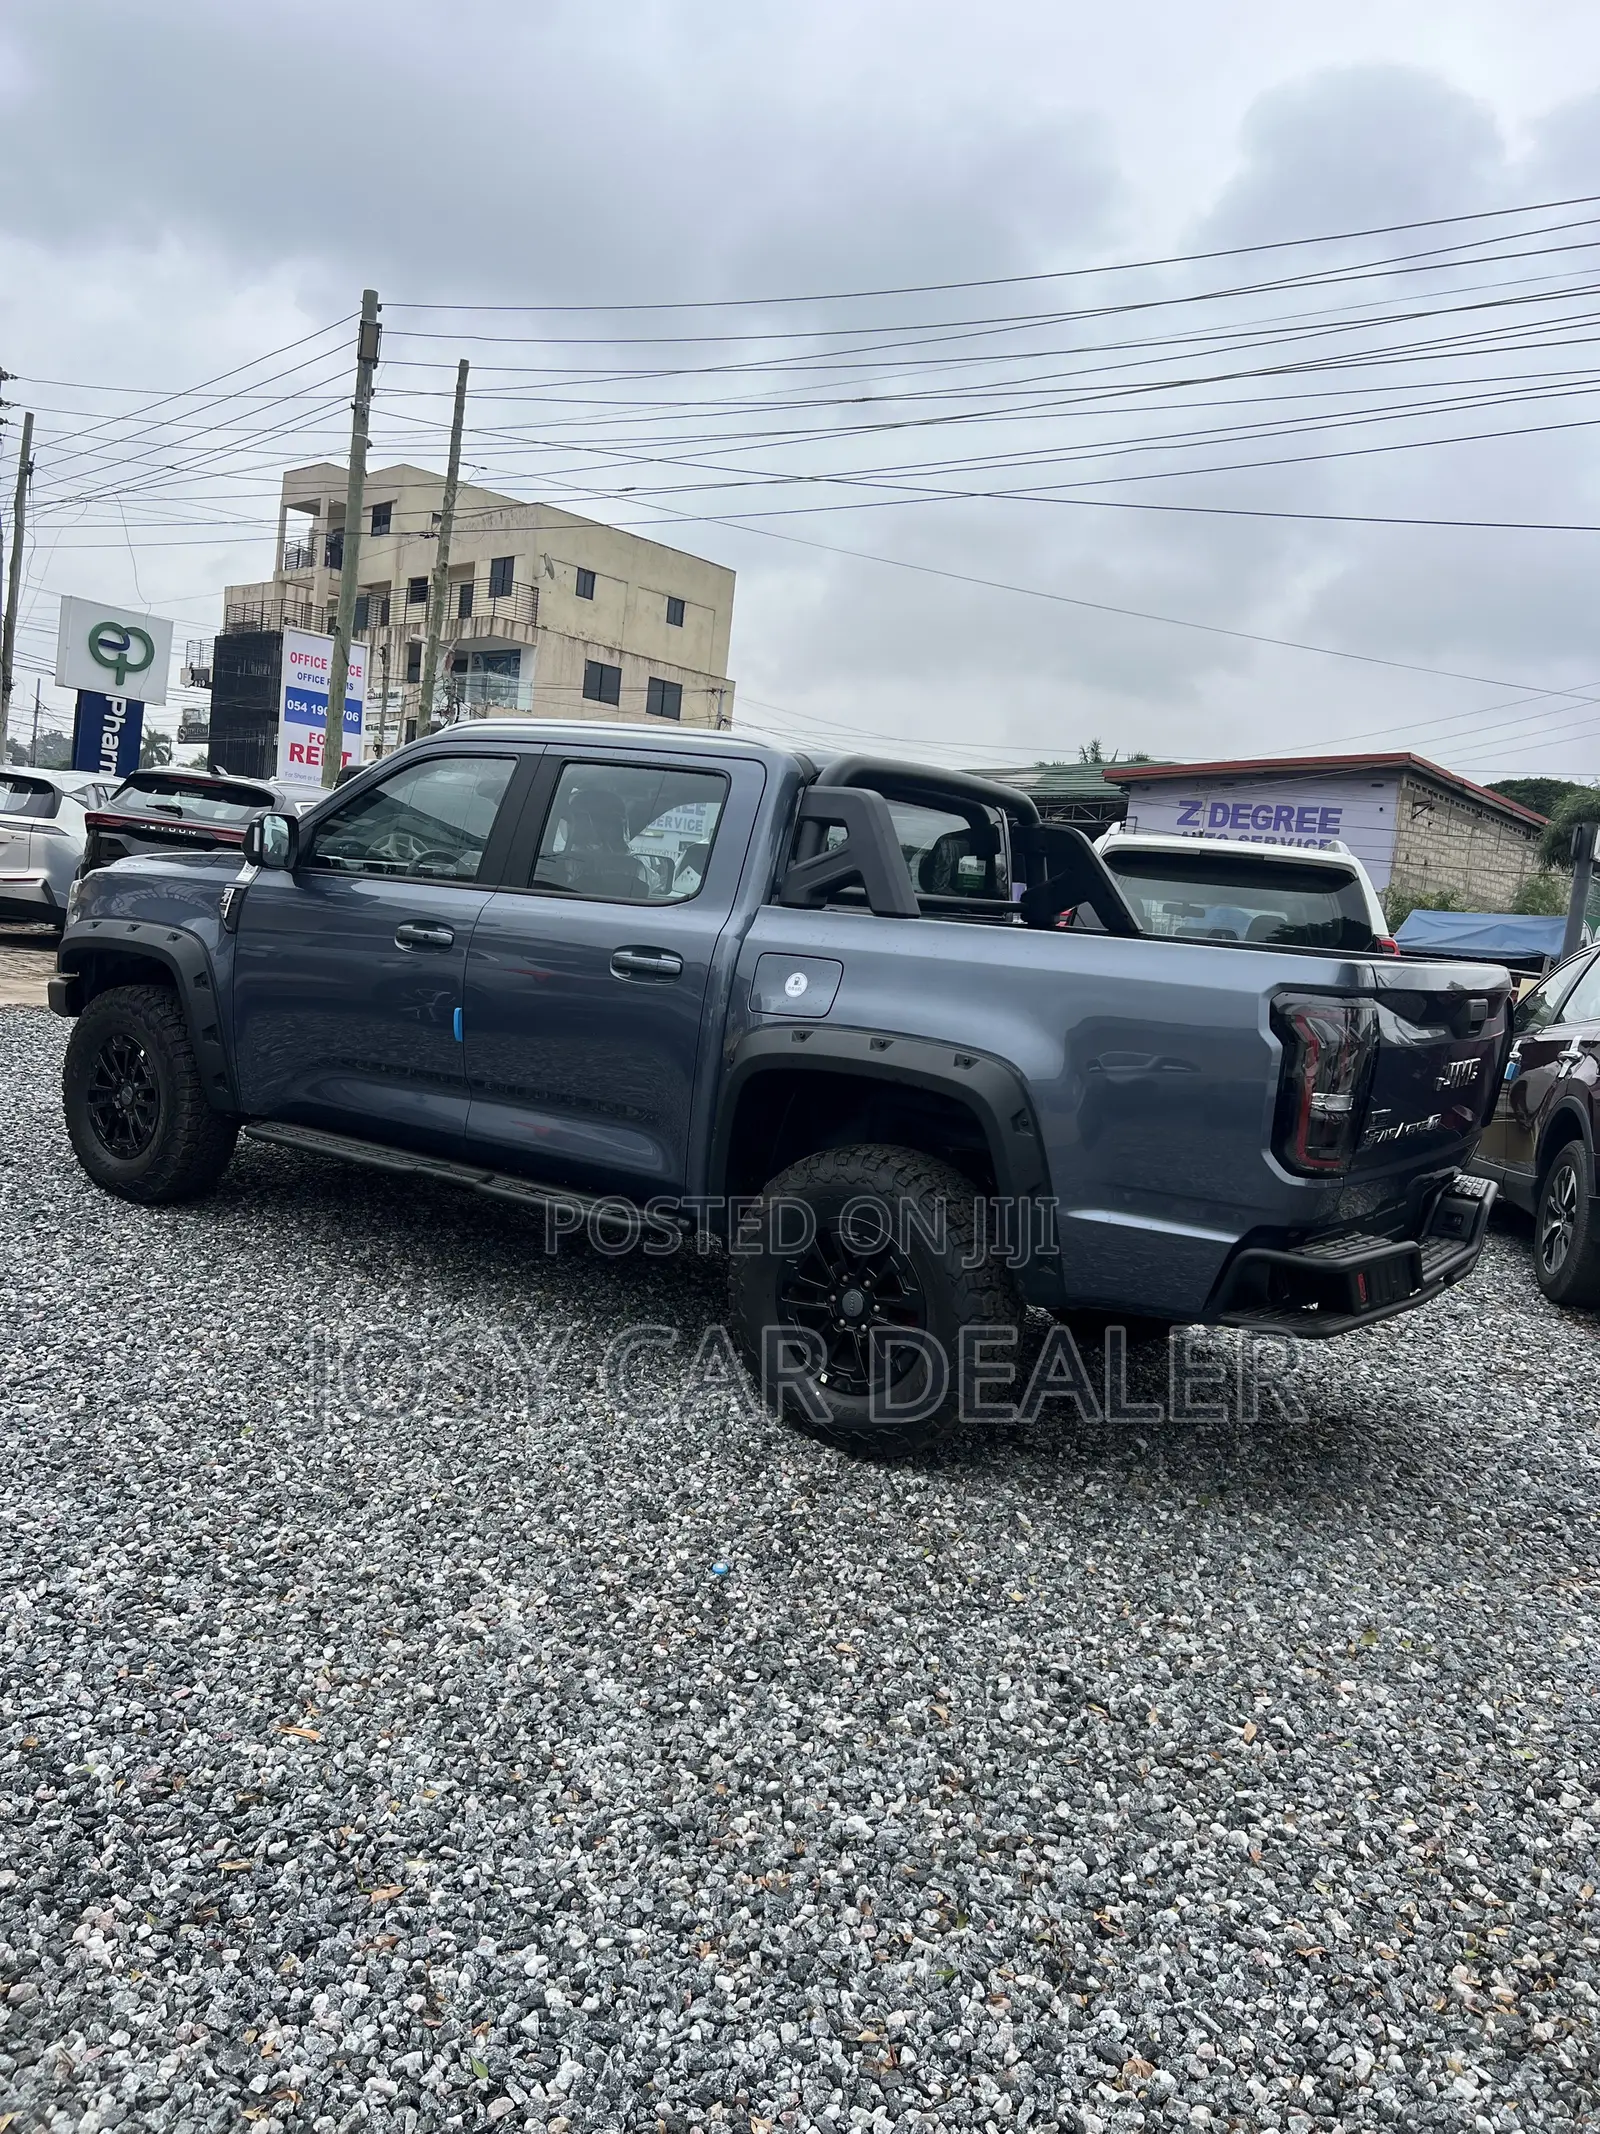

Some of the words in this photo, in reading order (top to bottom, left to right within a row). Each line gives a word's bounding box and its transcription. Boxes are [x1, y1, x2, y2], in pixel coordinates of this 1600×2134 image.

[290, 651, 328, 670] OFFICE
[297, 671, 325, 685] OFFICE
[287, 699, 308, 713] 054
[309, 732, 326, 746] FO
[289, 742, 353, 769] RET
[1177, 800, 1202, 827] Z
[1208, 802, 1343, 835] DEGREE
